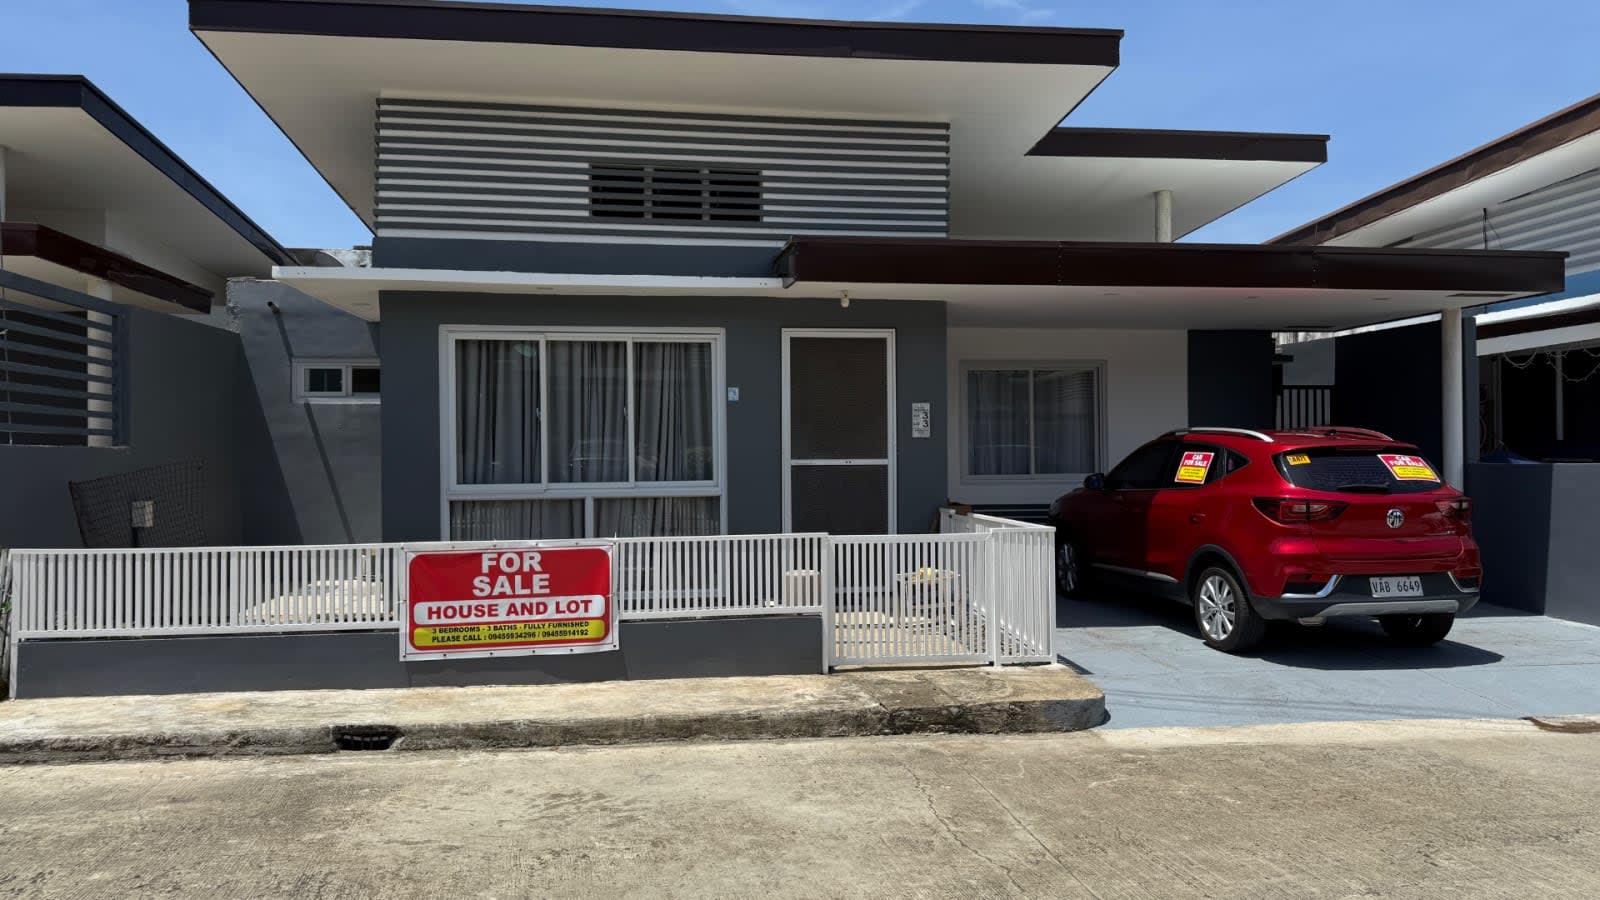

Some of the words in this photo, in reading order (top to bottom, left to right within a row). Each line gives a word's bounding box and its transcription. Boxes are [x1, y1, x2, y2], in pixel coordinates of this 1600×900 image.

[481, 552, 543, 574] FOR
[472, 574, 550, 597] SALE
[1372, 581, 1390, 592] VAB
[1396, 580, 1420, 592] 6649
[427, 604, 500, 620] HOUSE
[505, 602, 548, 617] AND
[555, 600, 593, 614] LOT
